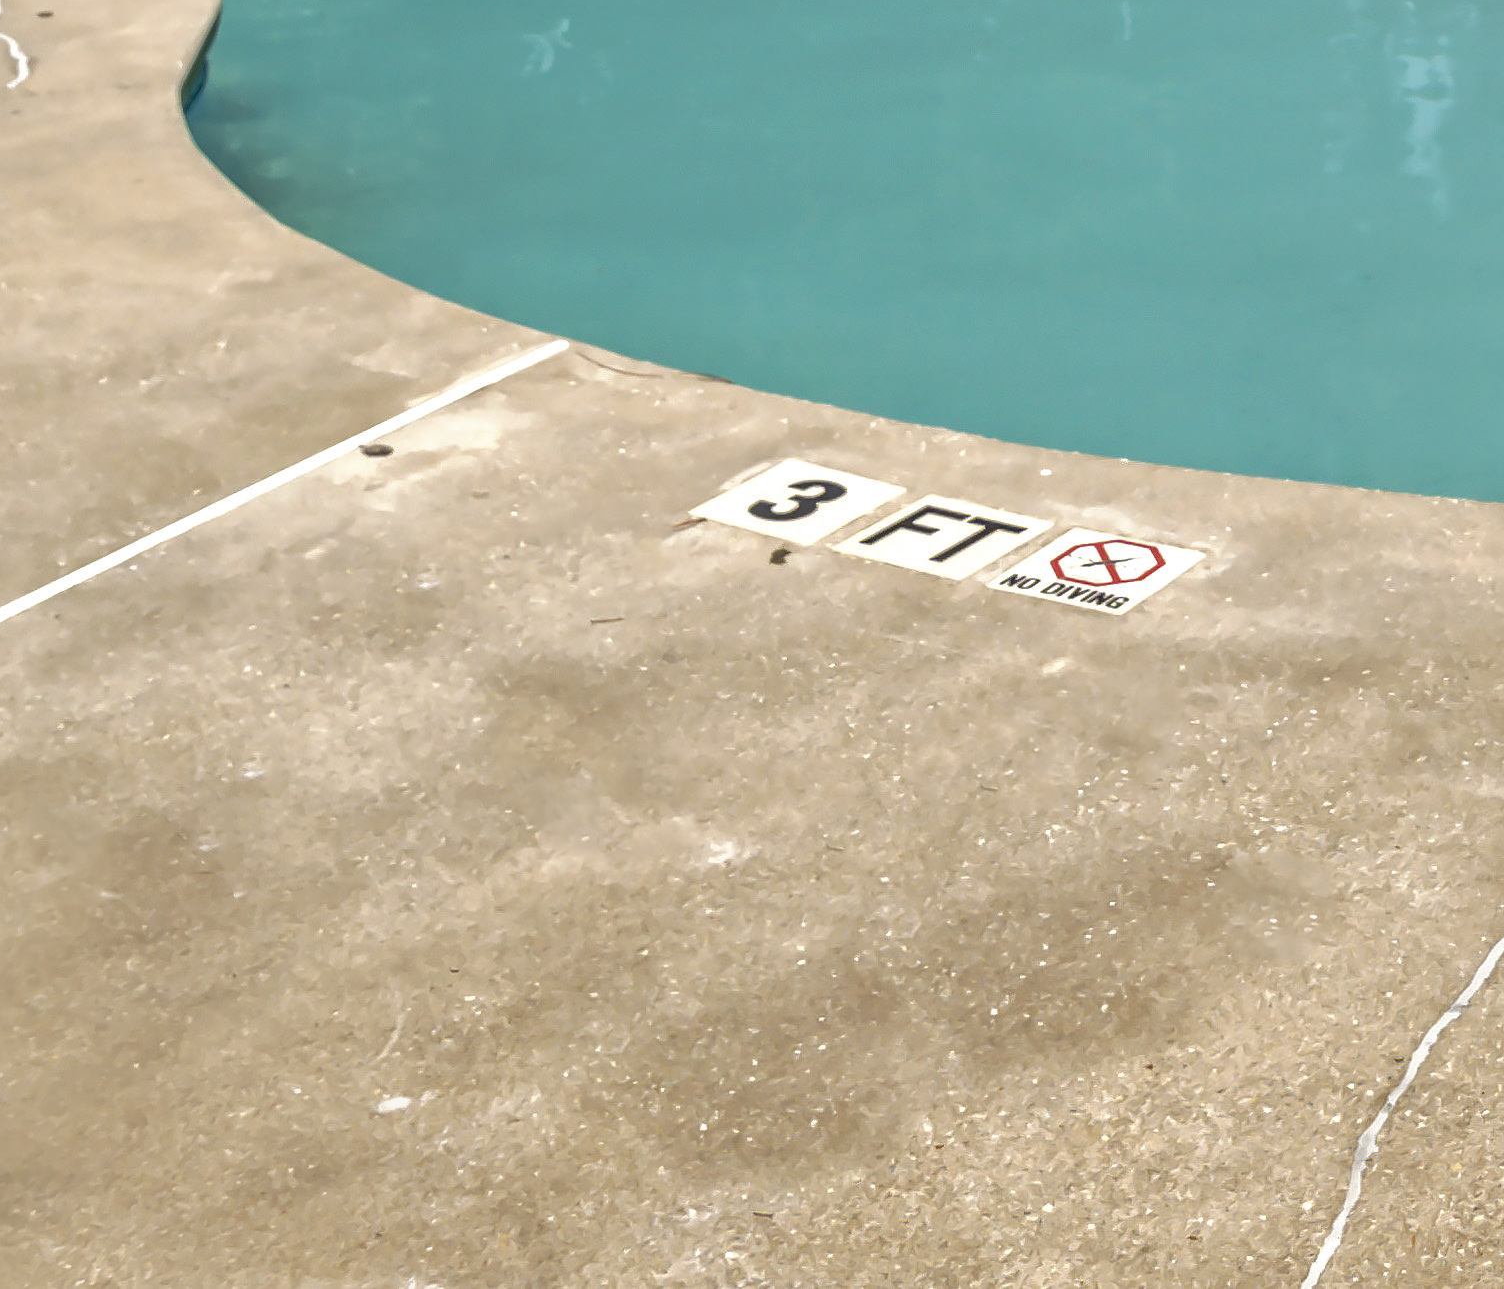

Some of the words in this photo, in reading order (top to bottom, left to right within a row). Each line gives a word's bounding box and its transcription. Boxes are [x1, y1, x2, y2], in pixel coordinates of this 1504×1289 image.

[748, 479, 848, 522] 3
[859, 504, 1029, 563] FT
[999, 573, 1041, 599] NO
[1040, 582, 1130, 609] DIVING
